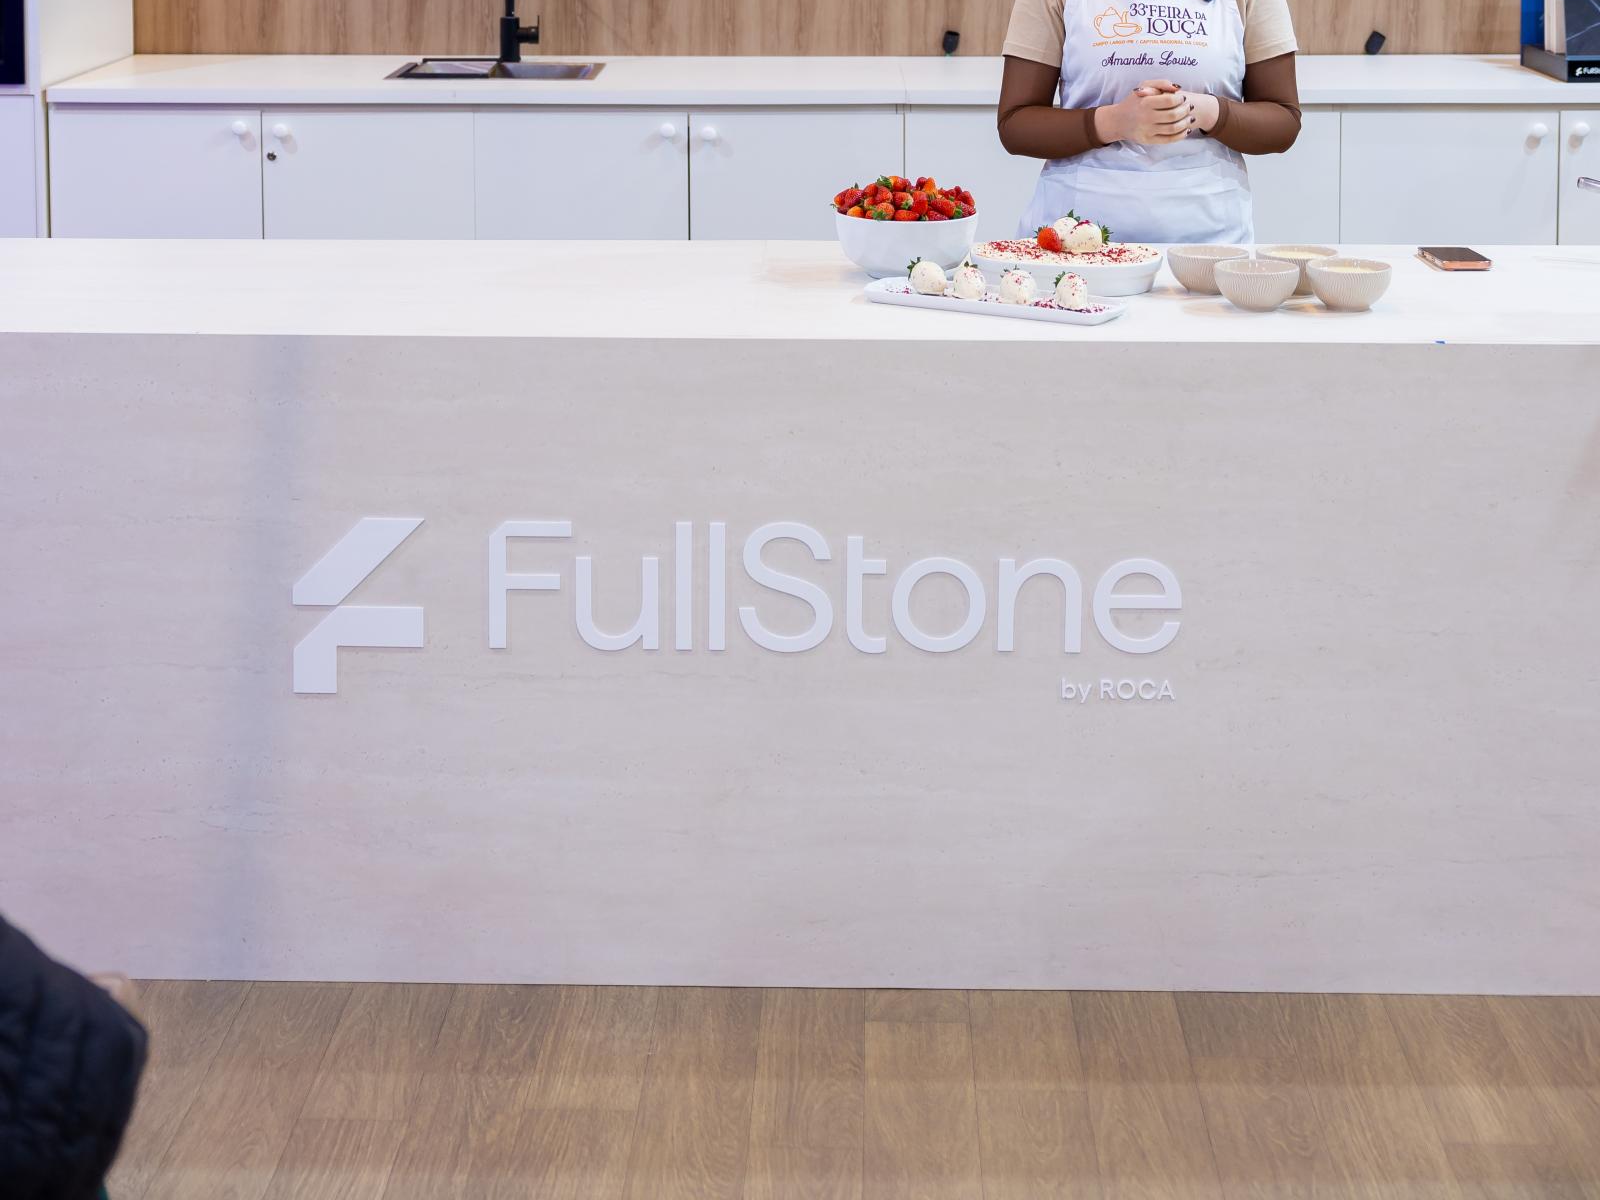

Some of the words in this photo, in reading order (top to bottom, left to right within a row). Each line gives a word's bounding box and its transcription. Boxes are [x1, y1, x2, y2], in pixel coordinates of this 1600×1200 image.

[1149, 5, 1193, 19] FEIRA
[1195, 11, 1207, 21] DA
[1147, 18, 1208, 39] LOUÇA
[1101, 51, 1155, 67] Amandha
[1159, 50, 1198, 67] Louise
[488, 520, 1183, 654] FullStone
[1061, 677, 1092, 703] by
[1099, 679, 1176, 700] ROCA
